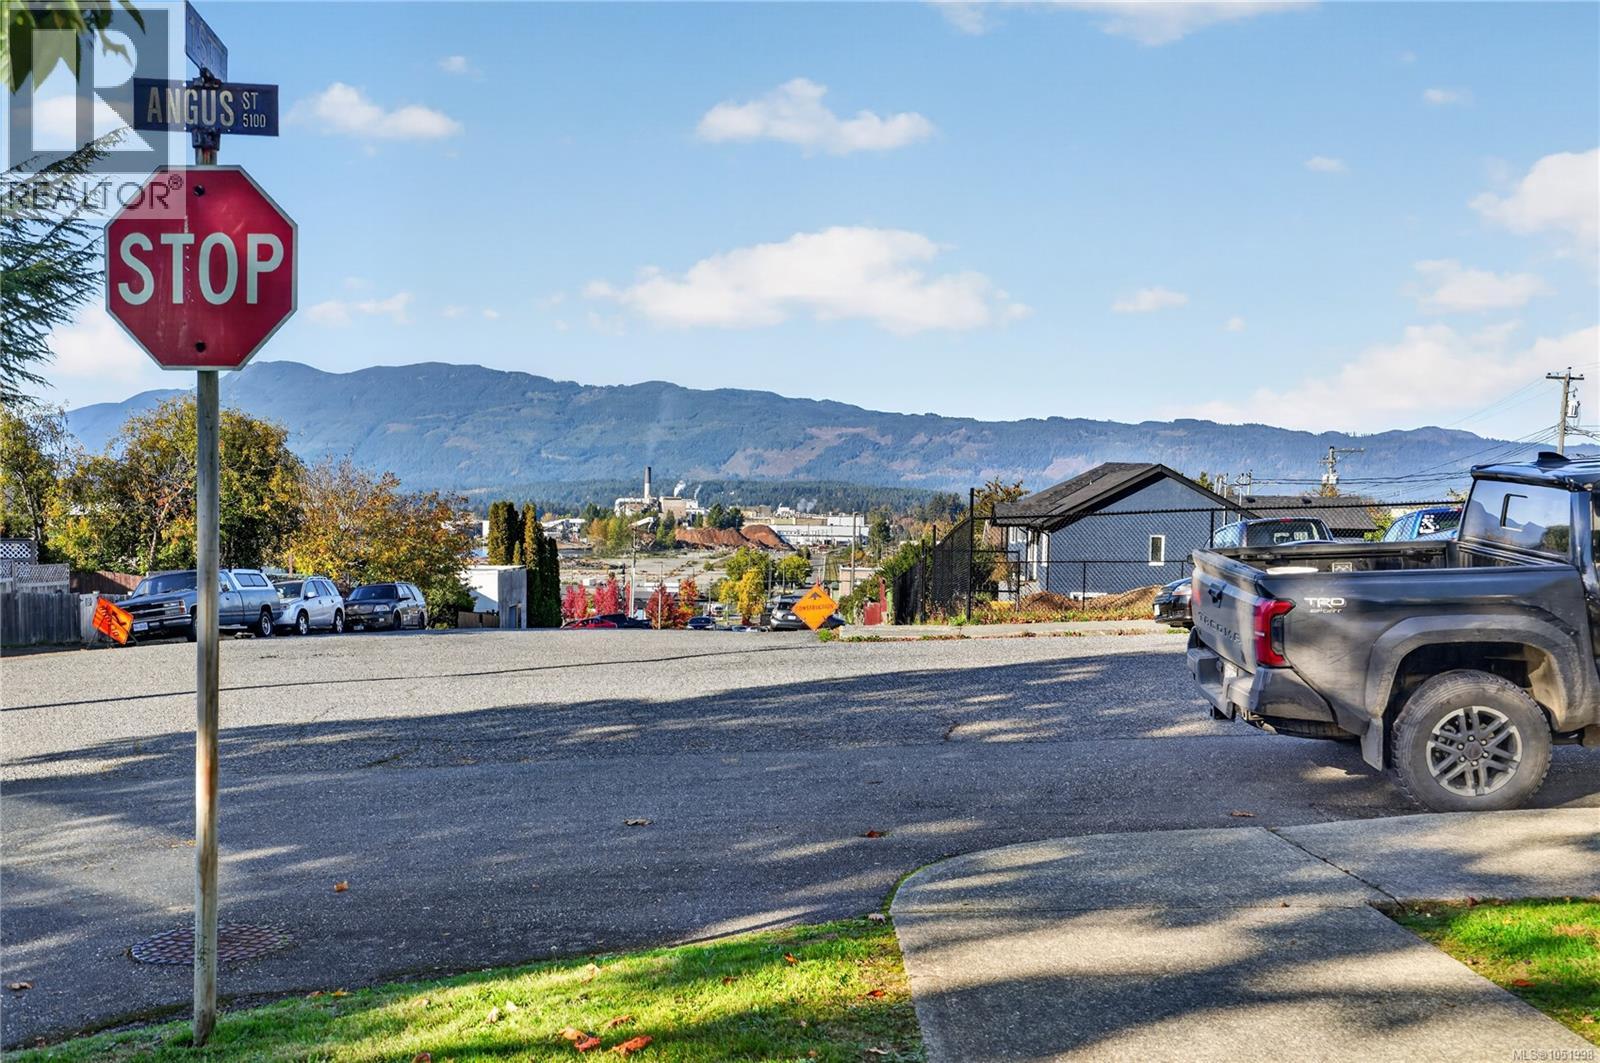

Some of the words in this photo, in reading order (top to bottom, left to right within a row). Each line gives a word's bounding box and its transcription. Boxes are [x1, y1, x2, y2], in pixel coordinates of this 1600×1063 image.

[147, 86, 235, 127] ANGUS
[242, 91, 259, 110] ST
[242, 113, 266, 128] 5100
[118, 232, 284, 305] STOP
[1303, 597, 1346, 608] TRD
